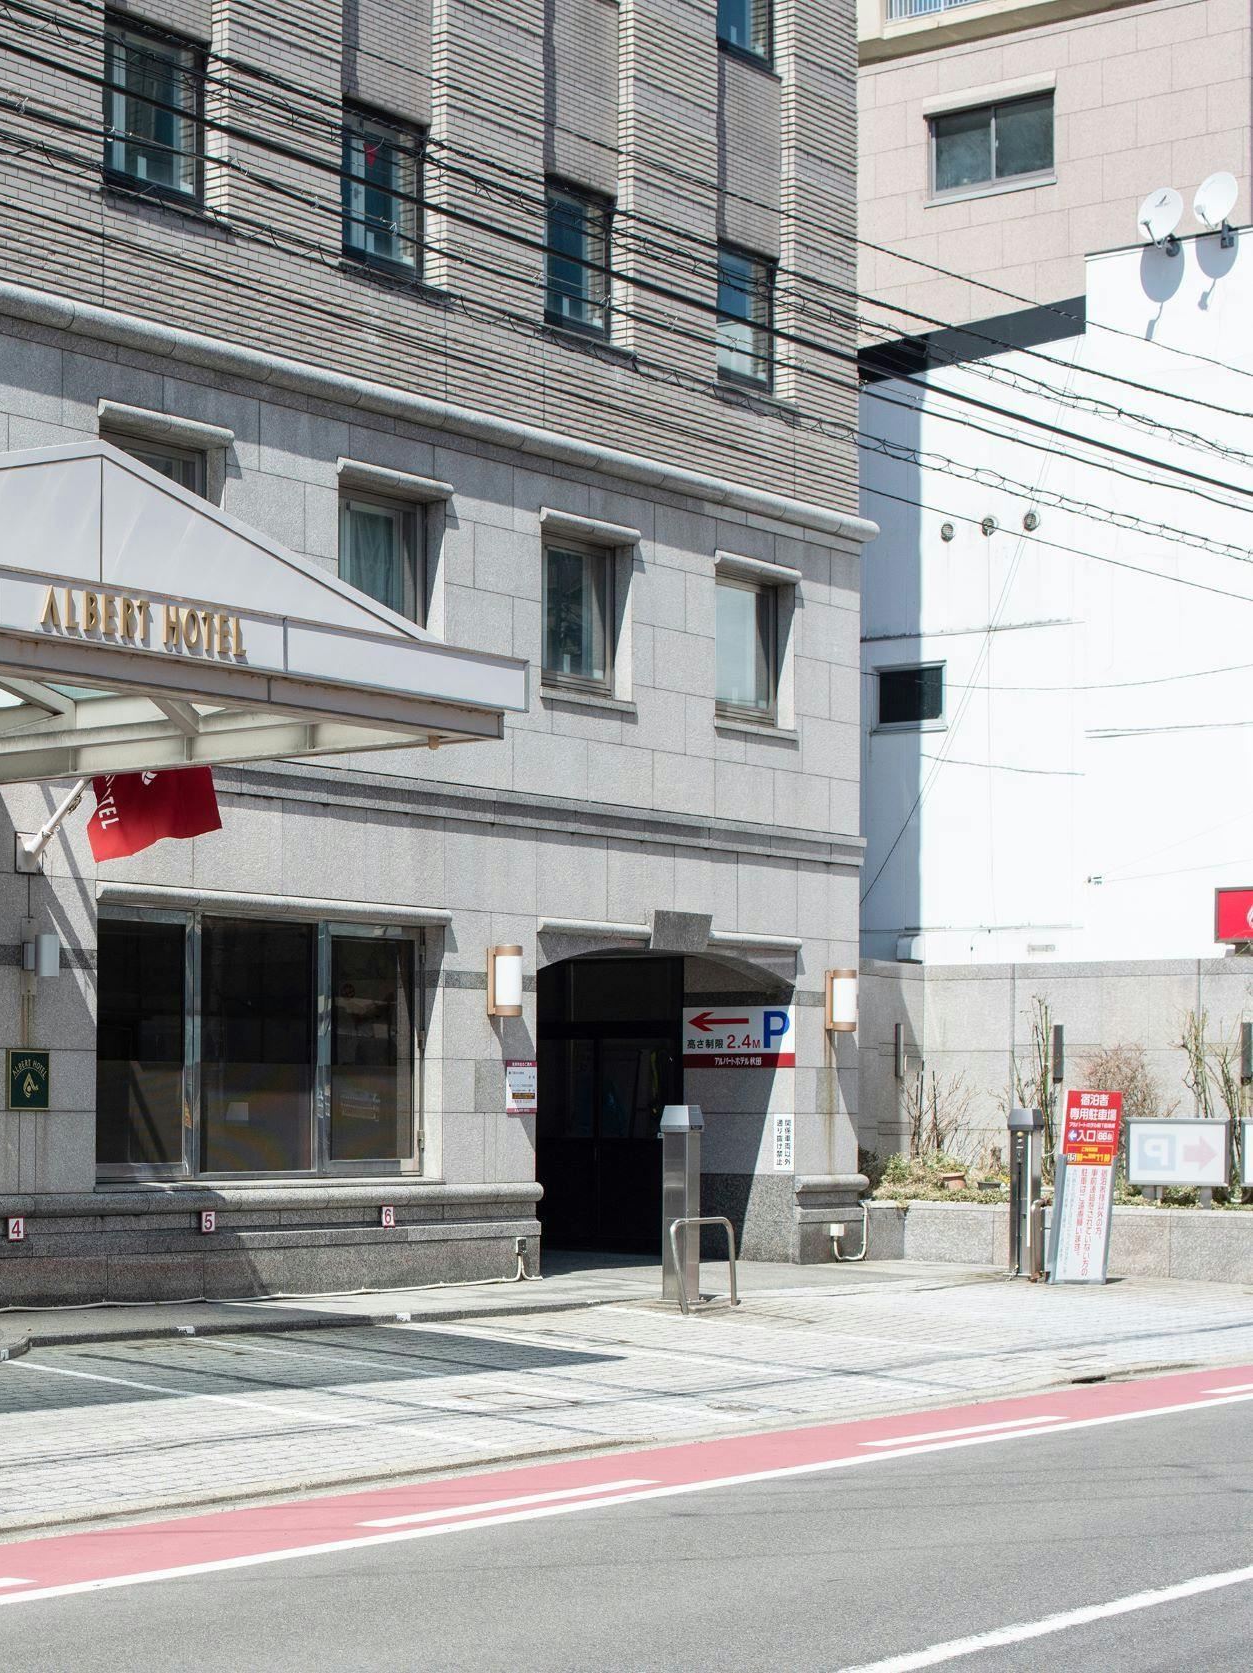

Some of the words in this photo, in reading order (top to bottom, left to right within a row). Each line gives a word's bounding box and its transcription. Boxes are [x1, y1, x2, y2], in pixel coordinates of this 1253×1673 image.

[40, 584, 151, 640] ALBERT
[162, 604, 247, 656] HOTEL
[763, 1010, 790, 1049] P
[686, 1038, 724, 1050] 高さ制限
[726, 1033, 761, 1050] 2.4M
[12, 1058, 32, 1077] ALBERT
[32, 1060, 48, 1077] HOTEL
[1080, 1093, 1110, 1107] 宿泊者
[1069, 1107, 1118, 1122] 専用駐車場
[1076, 1129, 1097, 1143] 入口
[204, 1214, 213, 1230] 5
[384, 1209, 392, 1224] 6
[11, 1220, 21, 1237] 4
